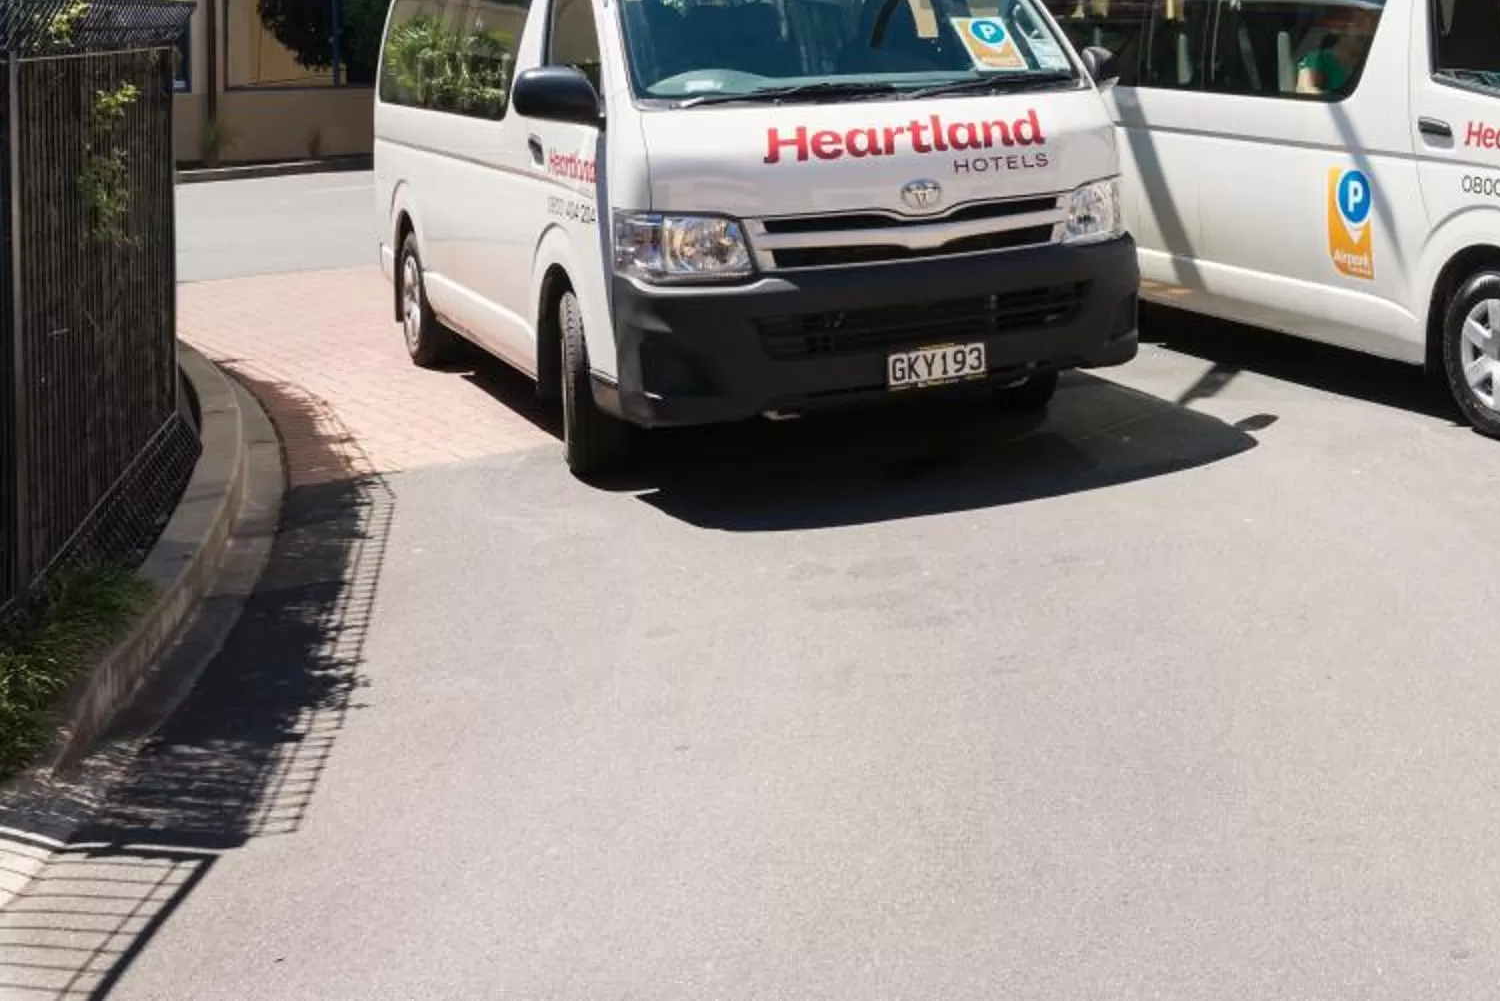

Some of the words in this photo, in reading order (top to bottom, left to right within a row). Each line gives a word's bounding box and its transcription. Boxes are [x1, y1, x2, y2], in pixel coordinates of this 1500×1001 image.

[763, 108, 1046, 164] Heartland
[953, 152, 1050, 174] HOTELS
[891, 346, 983, 382] GKY193
